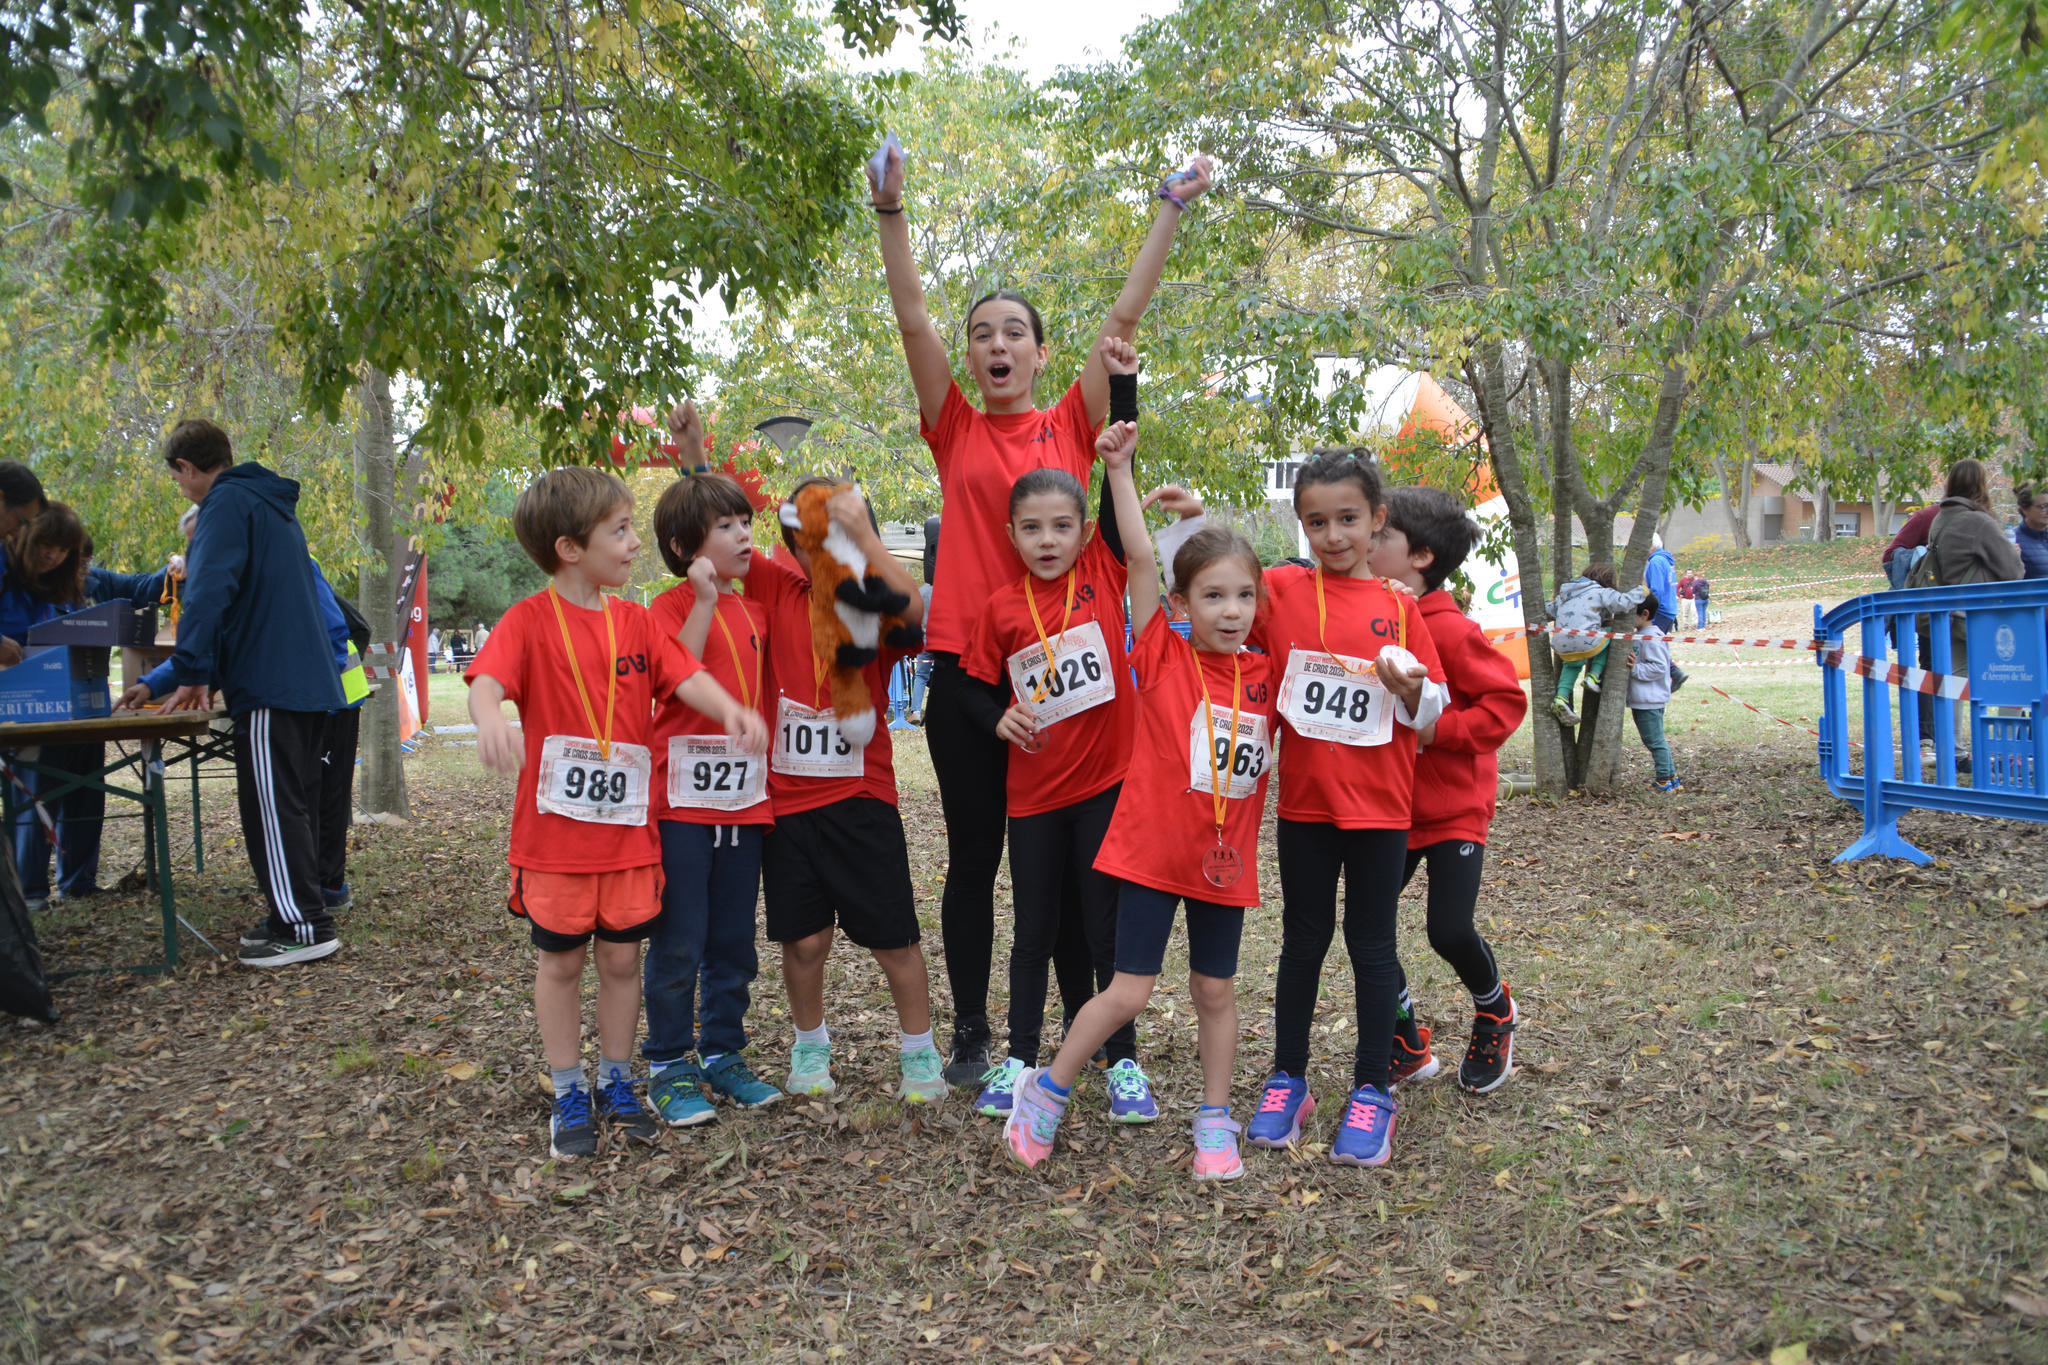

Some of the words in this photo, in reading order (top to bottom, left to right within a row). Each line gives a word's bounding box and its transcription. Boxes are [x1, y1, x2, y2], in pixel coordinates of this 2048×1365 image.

[1026, 652, 1101, 704] 1026
[1304, 662, 1312, 672] DE
[1312, 663, 1328, 675] CROS
[1328, 665, 1346, 678] 2025
[1988, 663, 2025, 672] Ajuntament
[1304, 681, 1370, 723] 948
[1237, 724, 1253, 736] 2025
[563, 747, 571, 757] DE
[572, 749, 588, 759] CROS
[1209, 737, 1264, 778] 963
[564, 766, 627, 803] 989
[693, 761, 748, 791] 927
